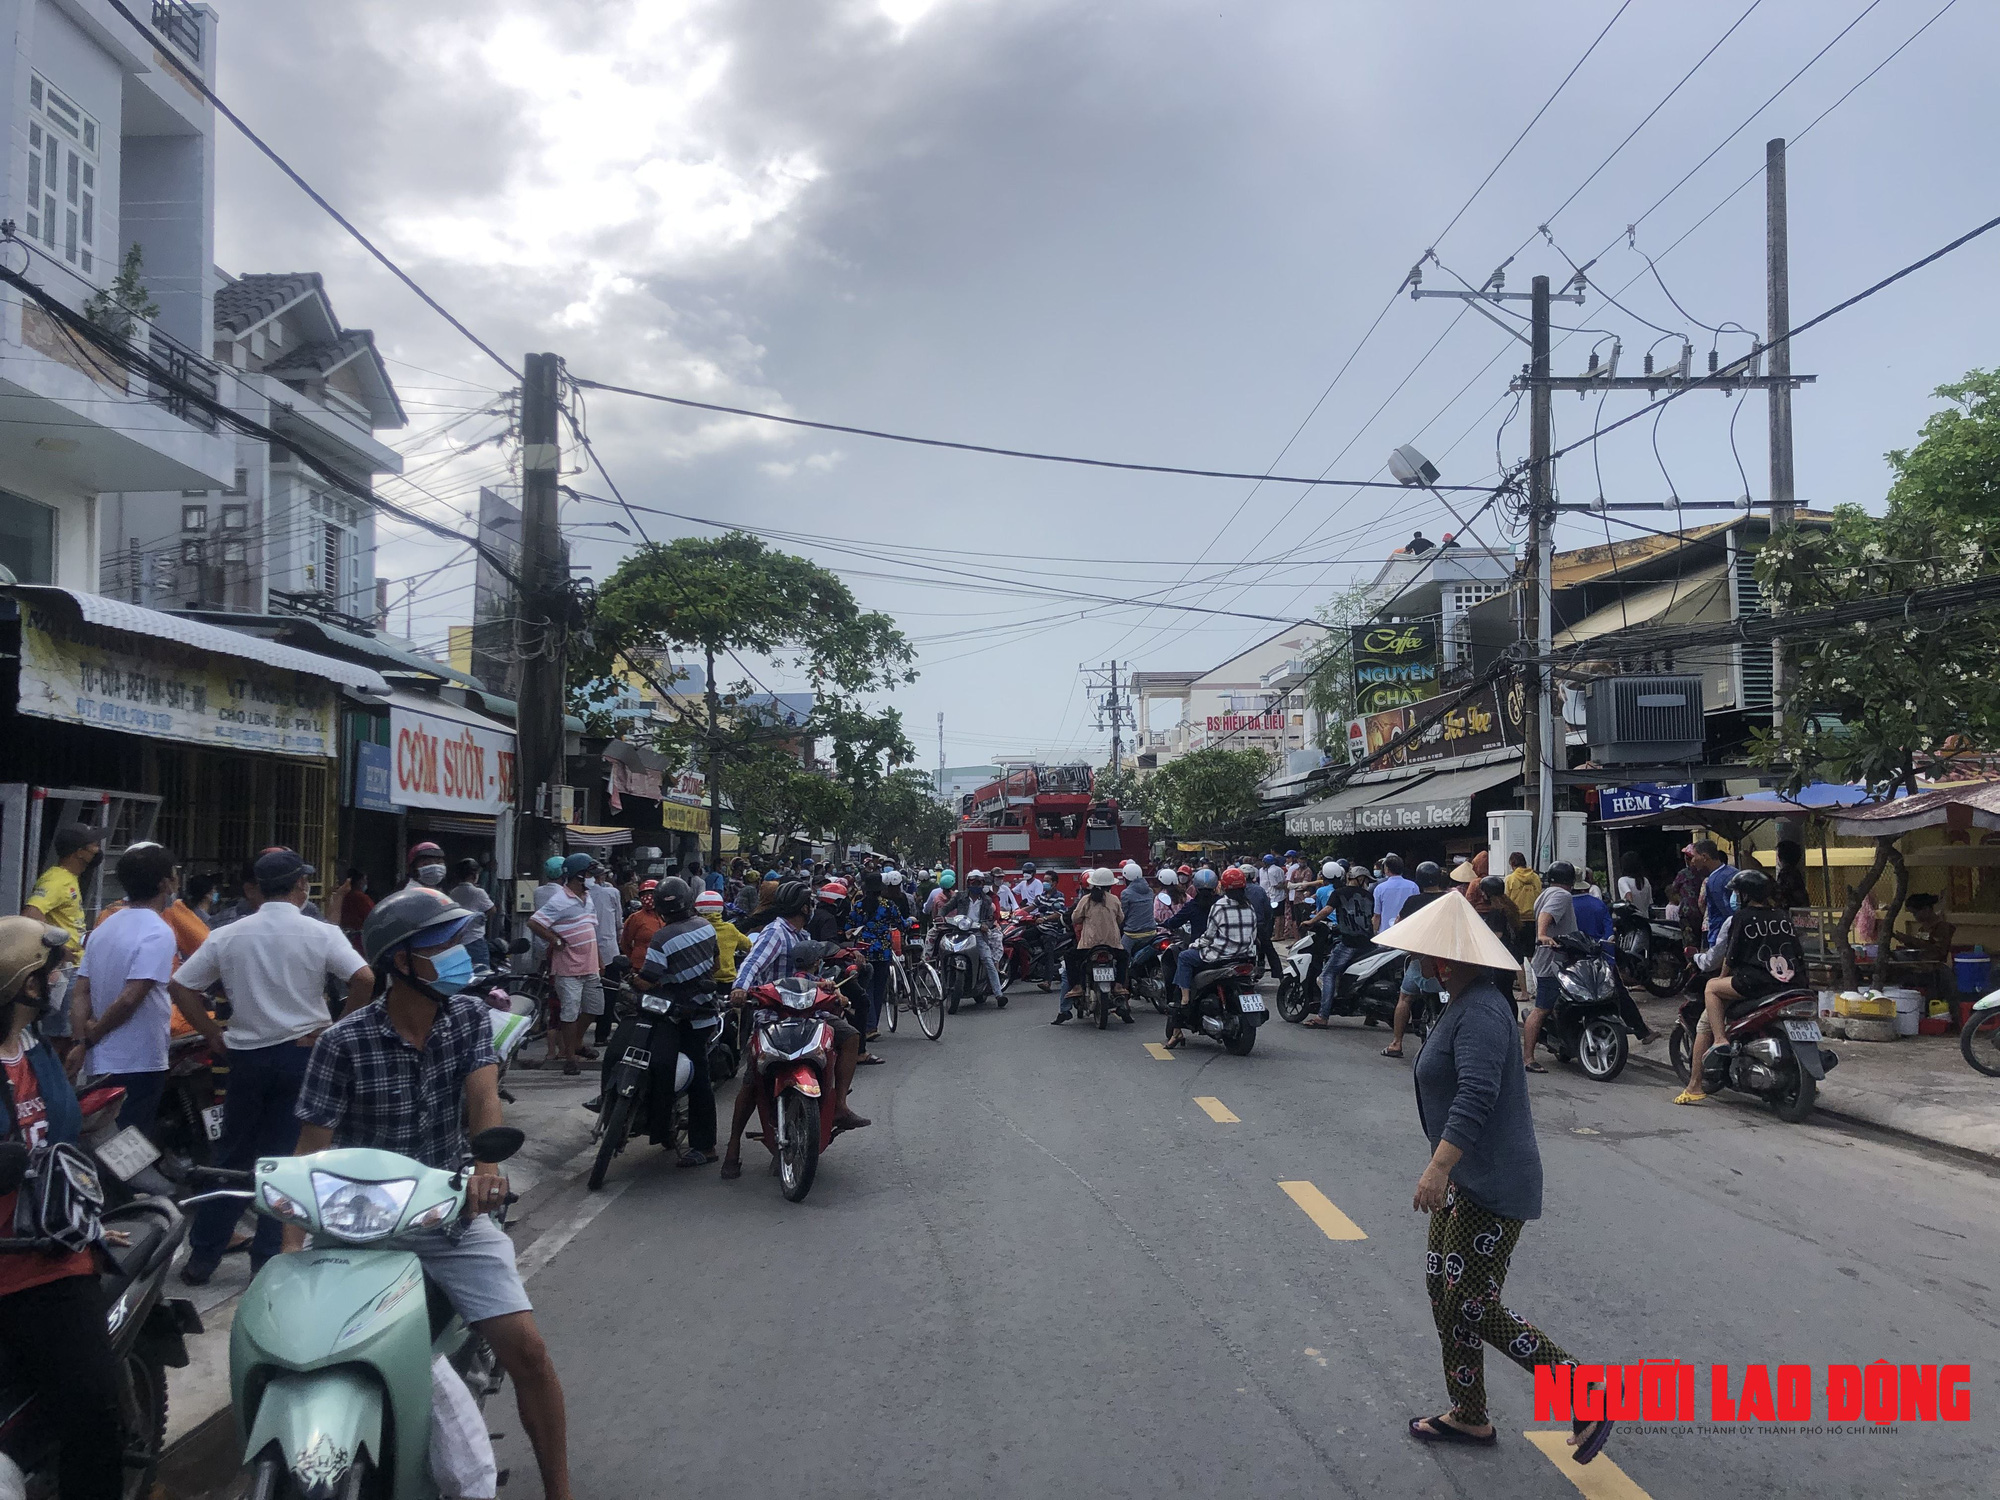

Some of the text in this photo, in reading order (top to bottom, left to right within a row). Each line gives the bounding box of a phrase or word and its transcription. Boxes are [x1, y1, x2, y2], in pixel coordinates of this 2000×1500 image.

[1364, 626, 1424, 655] Coffee
[1207, 716, 1220, 731] BS
[1444, 708, 1466, 741] Tee
[1467, 702, 1493, 736] Tee
[397, 722, 439, 795] CƠM
[443, 726, 485, 801] SƯỜN
[1612, 791, 1652, 813] HẺM
[1290, 817, 1309, 833] Café
[1310, 817, 1326, 832] Tee
[1327, 816, 1343, 832] Tee
[1362, 809, 1392, 828] Café
[1396, 807, 1421, 825] Tee
[1426, 804, 1453, 824] Tee
